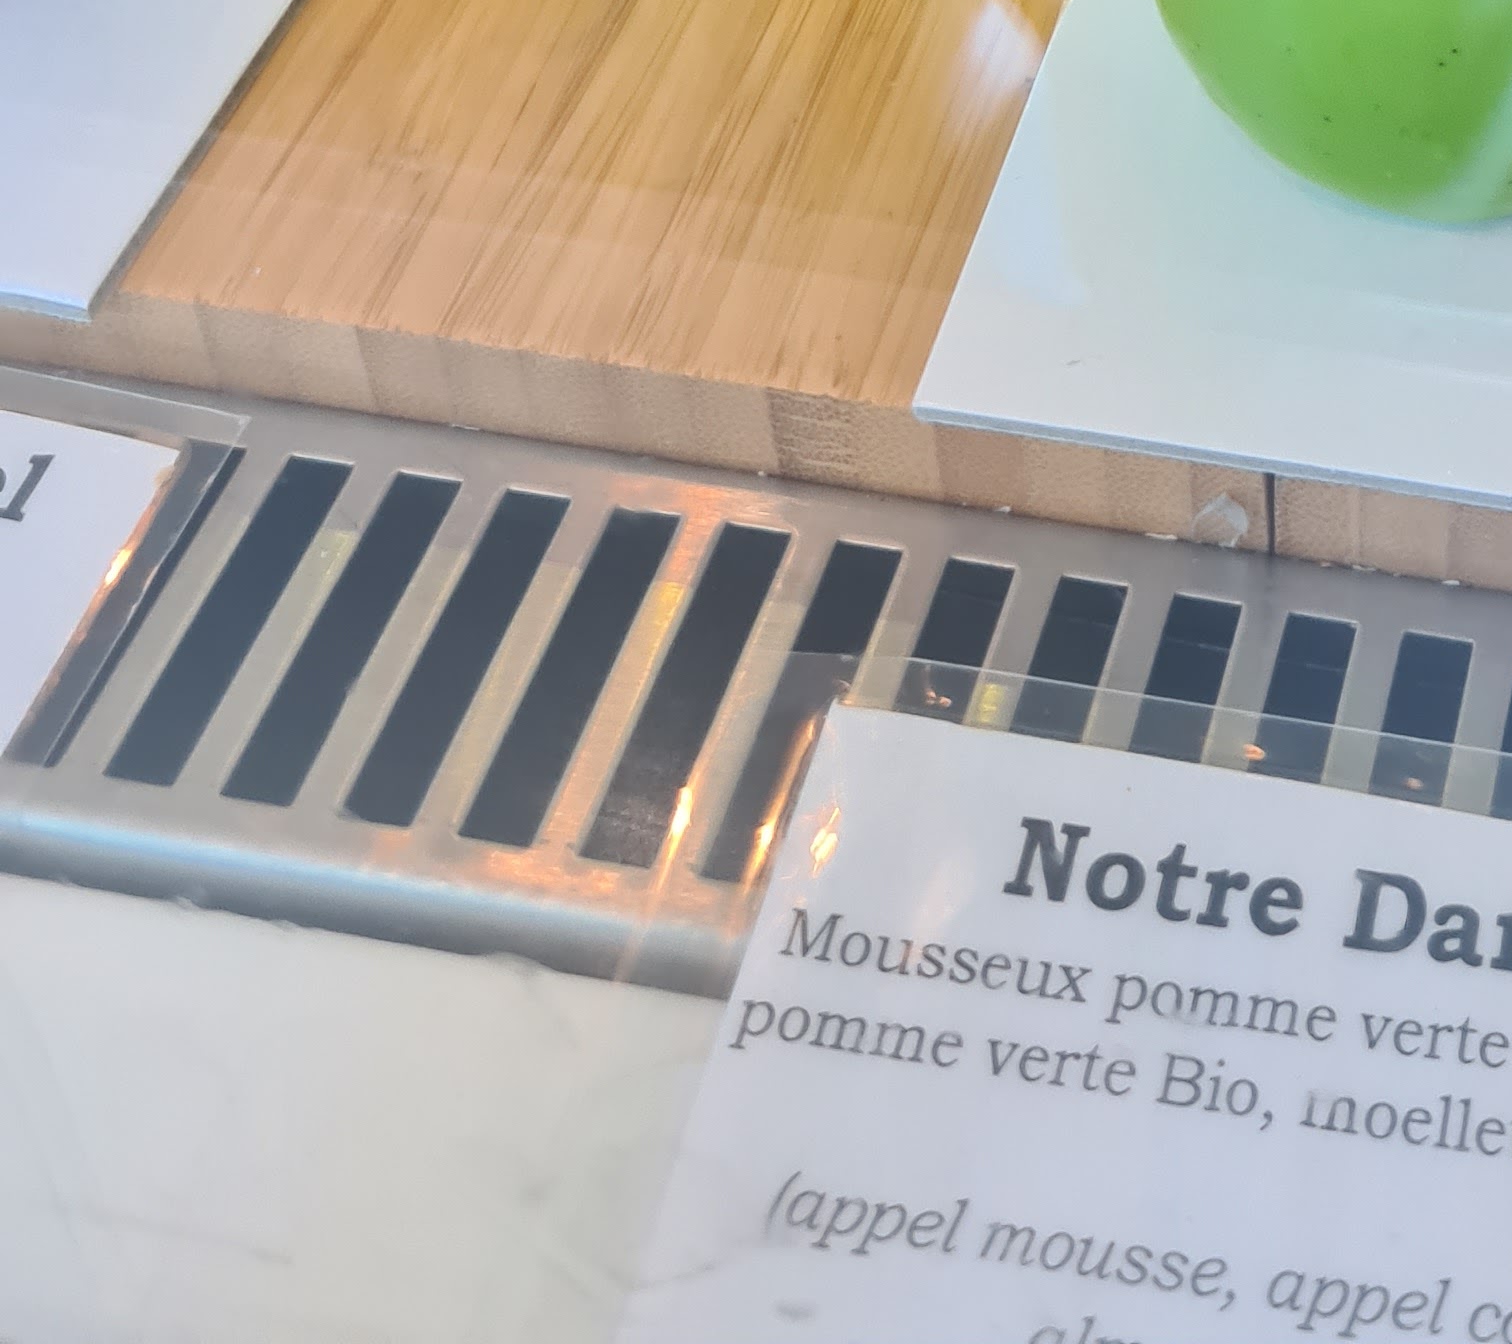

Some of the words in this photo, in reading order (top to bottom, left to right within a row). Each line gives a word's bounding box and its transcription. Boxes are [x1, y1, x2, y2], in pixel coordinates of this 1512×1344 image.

[1002, 817, 1303, 937] Notre
[781, 908, 1092, 1003] Mousseux
[1104, 973, 1337, 1042] pomme
[1361, 1013, 1509, 1068] verte
[729, 1000, 963, 1068] pomme
[988, 1039, 1136, 1096] verte
[1156, 1053, 1273, 1131] Bio,
[764, 1171, 970, 1256] (appel
[979, 1222, 1236, 1311] mousse,
[1266, 1269, 1452, 1340] appel
